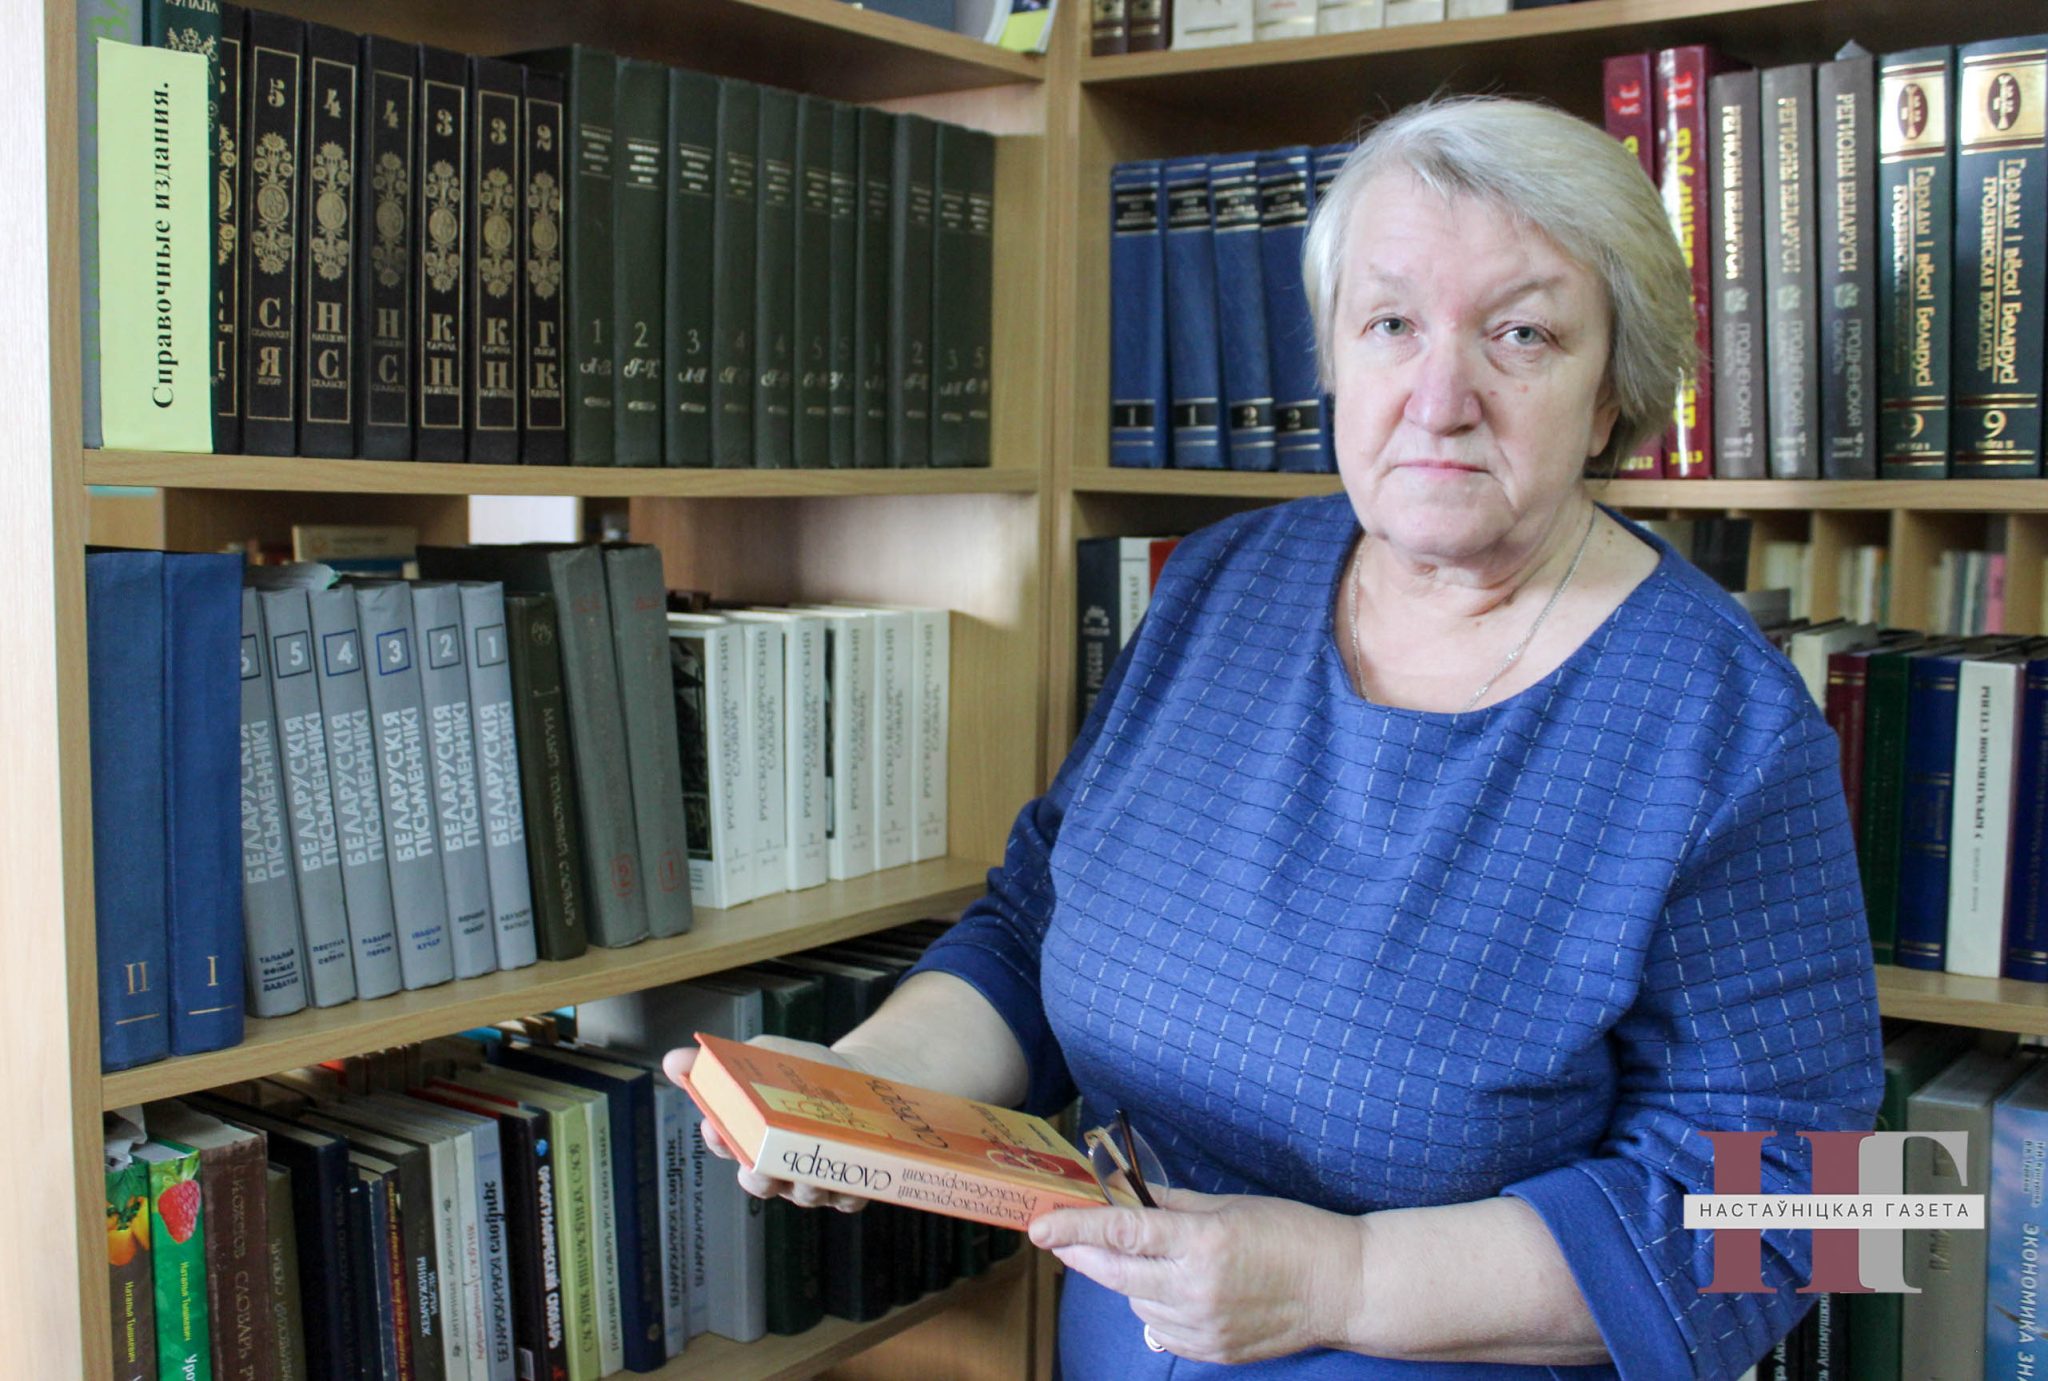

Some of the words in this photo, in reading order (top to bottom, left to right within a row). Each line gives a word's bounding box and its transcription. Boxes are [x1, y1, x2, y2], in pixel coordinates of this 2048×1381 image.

[268, 78, 285, 107] 5
[325, 88, 341, 117] 4
[384, 100, 399, 128] 4
[437, 109, 453, 136] 3
[154, 82, 174, 209] издания.
[491, 118, 507, 146] 3
[537, 124, 553, 151] 2
[1722, 105, 1742, 187] РЕГИОНЫ
[1778, 98, 1798, 180] РЕГИОНЫ
[1836, 93, 1856, 178] РЕГИОНЫ
[1911, 166, 1935, 234] Гарады
[1999, 158, 2026, 229] Гарады
[1722, 191, 1743, 280] БЕЛАРУСИ
[1780, 184, 1800, 273] БЕЛАРУСИ
[1837, 182, 1857, 272] БЕЛАРУСИ
[1979, 177, 1998, 286] ГРОДЗЕНСКАЯ
[2003, 248, 2023, 296] вёскі
[151, 215, 180, 409] Справочные
[258, 297, 281, 329] С
[317, 301, 342, 333] Н
[378, 308, 400, 338] Н
[431, 313, 455, 342] К
[486, 318, 510, 345] К
[538, 321, 554, 347] Г
[633, 321, 649, 348] 2
[687, 330, 700, 355] 3
[1976, 291, 1995, 372] ВОБЛАСЦЬ
[1994, 302, 2022, 384] Беларусі
[258, 346, 282, 377] Я
[318, 349, 340, 380] С
[378, 353, 399, 384] С
[430, 357, 453, 386] Н
[485, 361, 508, 389] Н
[535, 363, 558, 389] К
[1909, 306, 1935, 387] Беларусі
[1983, 410, 2008, 439] 9
[291, 642, 304, 666] 5
[338, 641, 353, 665] 4
[389, 640, 403, 664] 3
[439, 634, 453, 658] 2
[487, 636, 497, 659] 1
[720, 634, 736, 830] РУССКО-БЕЛОРУССКИЙ
[756, 630, 769, 821] РУССКО-БЕЛОРУССКИЙ
[802, 631, 813, 819] РУССКО-БЕЛОРУССКИЙ
[850, 628, 860, 810] РУССКО-БЕЛОРУССКИЙ
[885, 628, 895, 806] РУССКО-БЕЛОРУССКИЙ
[922, 624, 934, 798] РУССКО-БЕЛОРУССКИЙ
[1979, 686, 1991, 733] СТЕНЫ
[252, 720, 286, 880] ПІСЬМЕННІКІ
[285, 714, 322, 873] БЕЛАРУСКІЯ
[303, 711, 340, 868] ПІСЬМЕННІКІ
[331, 712, 367, 868] БЕЛАРУСКІЯ
[351, 708, 385, 863] ПІСЬМЕННІКІ
[382, 711, 416, 863] БЕЛАРУСКІЯ
[400, 707, 434, 858] ПІСЬМЕННІКІ
[432, 704, 464, 853] БЕЛАРУСКІЯ
[451, 701, 481, 848] ПІСЬМЕННІКІ
[480, 703, 510, 848] БЕЛАРУСКІЯ
[498, 700, 524, 844] ПІСЬМЕННІКІ
[549, 773, 570, 857] ТОЛКОВЫЙ
[558, 861, 577, 928] СЛОВАРЬ
[124, 961, 150, 995] II
[567, 1143, 582, 1184] СЛОЎ
[666, 1138, 683, 1207] слоўнік
[902, 1168, 1037, 1212] Русско-белорусский
[482, 1180, 504, 1254] слоўнік
[538, 1165, 560, 1289] ОРФОГРАФИЧЕСКИЙ
[600, 1172, 612, 1229] РУССКОГО
[180, 1262, 191, 1297] Наталья
[604, 1232, 616, 1285] СЛОВАРЬ
[2018, 1223, 2040, 1344] ЭКОНОМИКА
[125, 1281, 135, 1317] Наталья
[181, 1299, 193, 1341] Тышкевич
[235, 1271, 253, 1359] СЛОВАРЬ
[416, 1256, 431, 1338] ЖЕМЧУЖИНЫ
[546, 1292, 562, 1349] СЛОВАРЬ
[577, 1290, 593, 1352] СЛОЎНІК
[607, 1287, 621, 1351] ТОЛКОВЫЙ
[127, 1318, 138, 1363] Тышкевич
